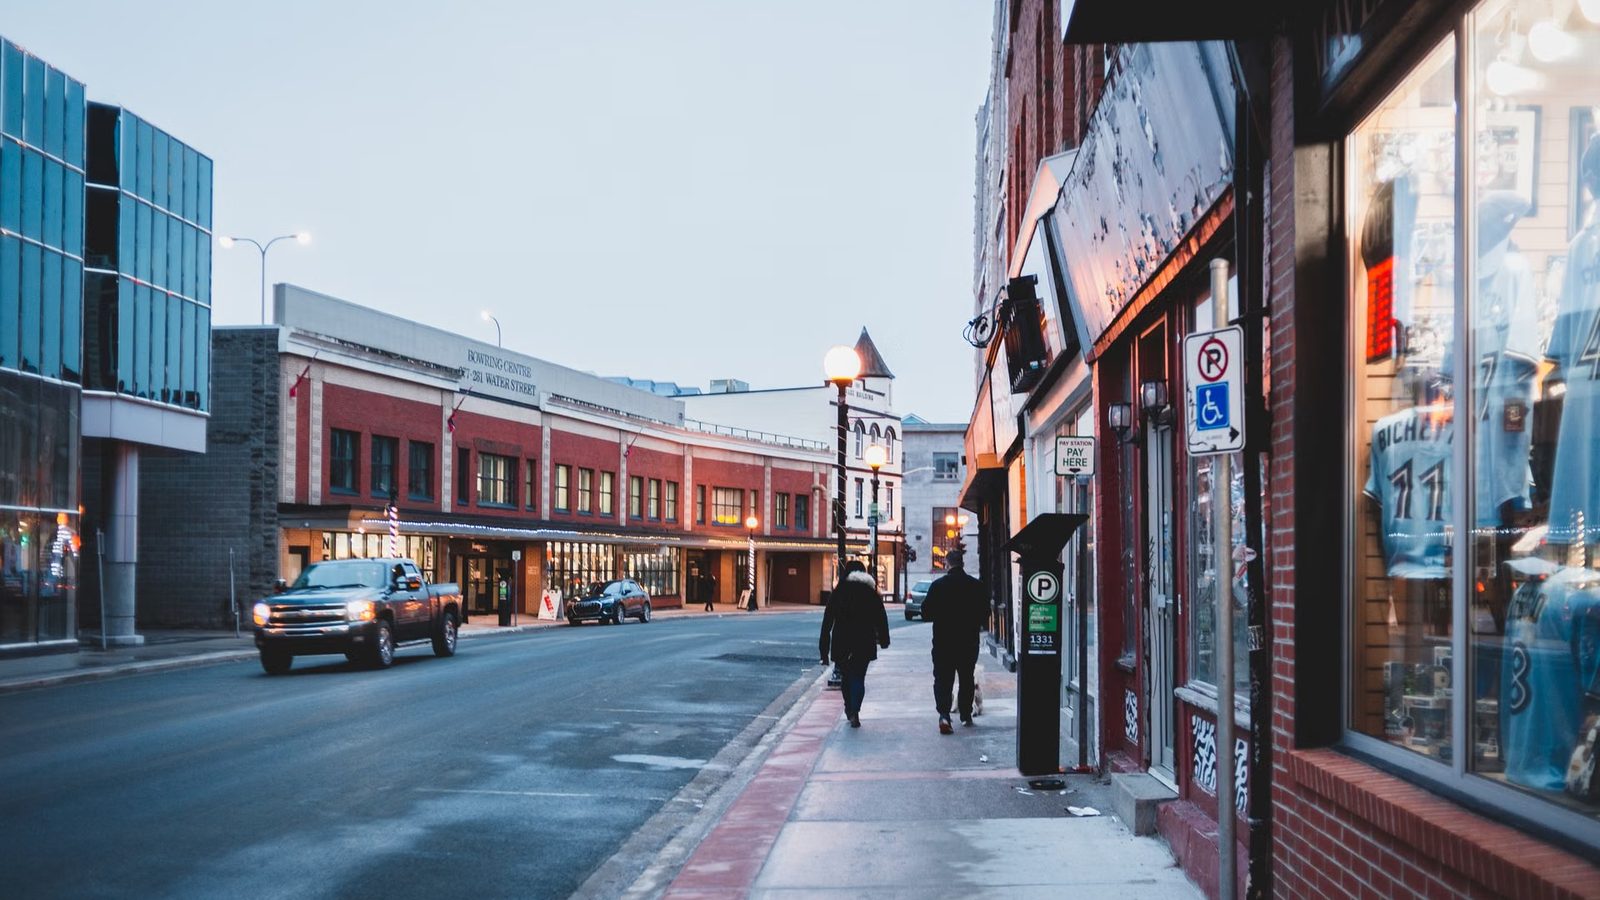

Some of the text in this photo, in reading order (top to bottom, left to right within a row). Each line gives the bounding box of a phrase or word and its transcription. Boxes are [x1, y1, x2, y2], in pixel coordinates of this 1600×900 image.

[467, 349, 532, 378] BOWRING CENTRE
[485, 373, 510, 389] WATER
[510, 378, 536, 397] STREET
[1378, 416, 1454, 453] BICHE
[1062, 457, 1088, 467] HERE
[1066, 447, 1084, 457] PAY
[1387, 457, 1445, 522] 11
[1037, 577, 1052, 597] P
[1030, 635, 1054, 644] 1331
